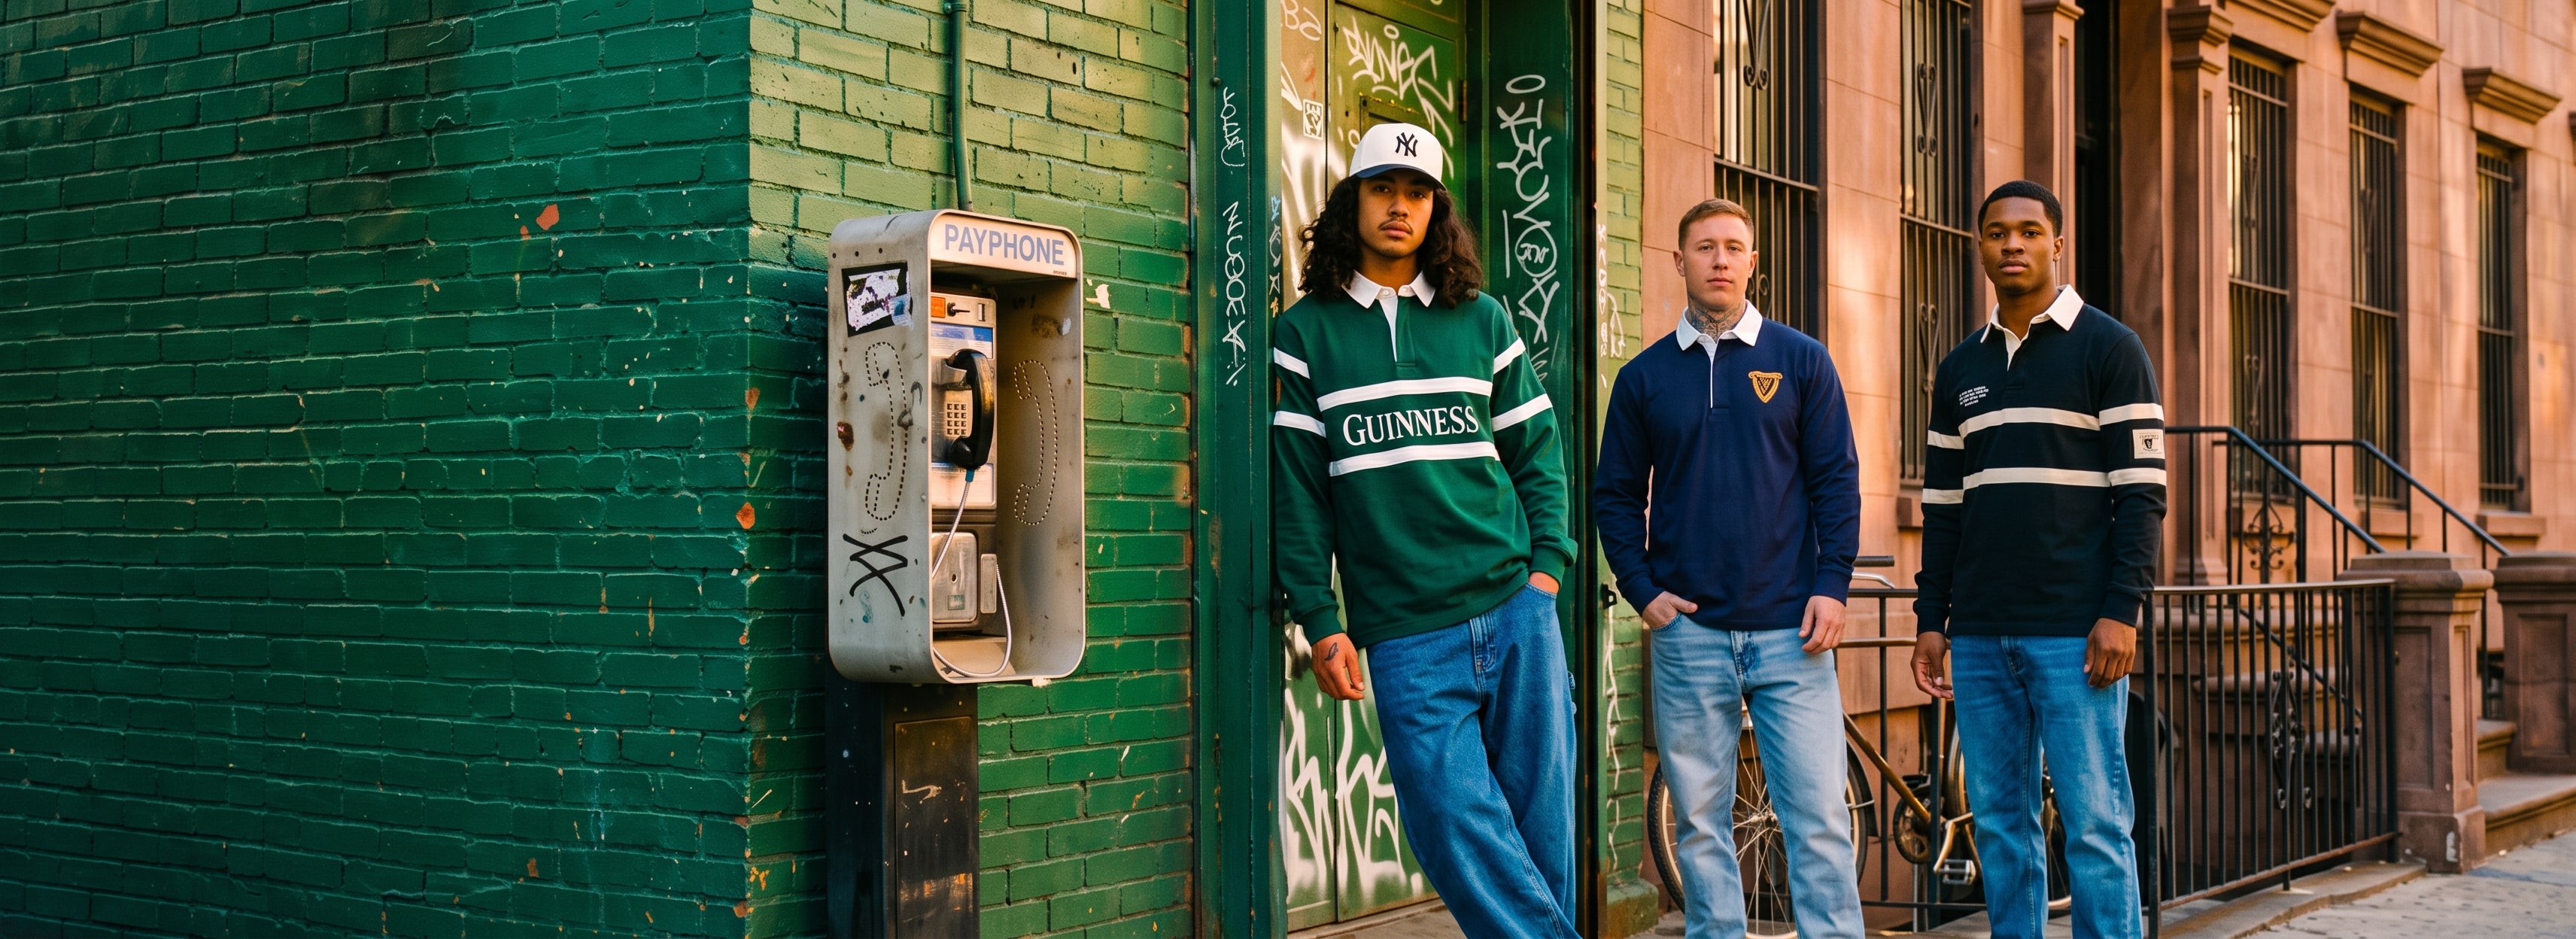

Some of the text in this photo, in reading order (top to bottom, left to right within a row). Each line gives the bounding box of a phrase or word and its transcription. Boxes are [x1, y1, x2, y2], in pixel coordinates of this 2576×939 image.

[1395, 132, 1418, 157] NY
[945, 224, 1065, 266] PAYPHONE
[1343, 406, 1479, 446] GUINNESS
